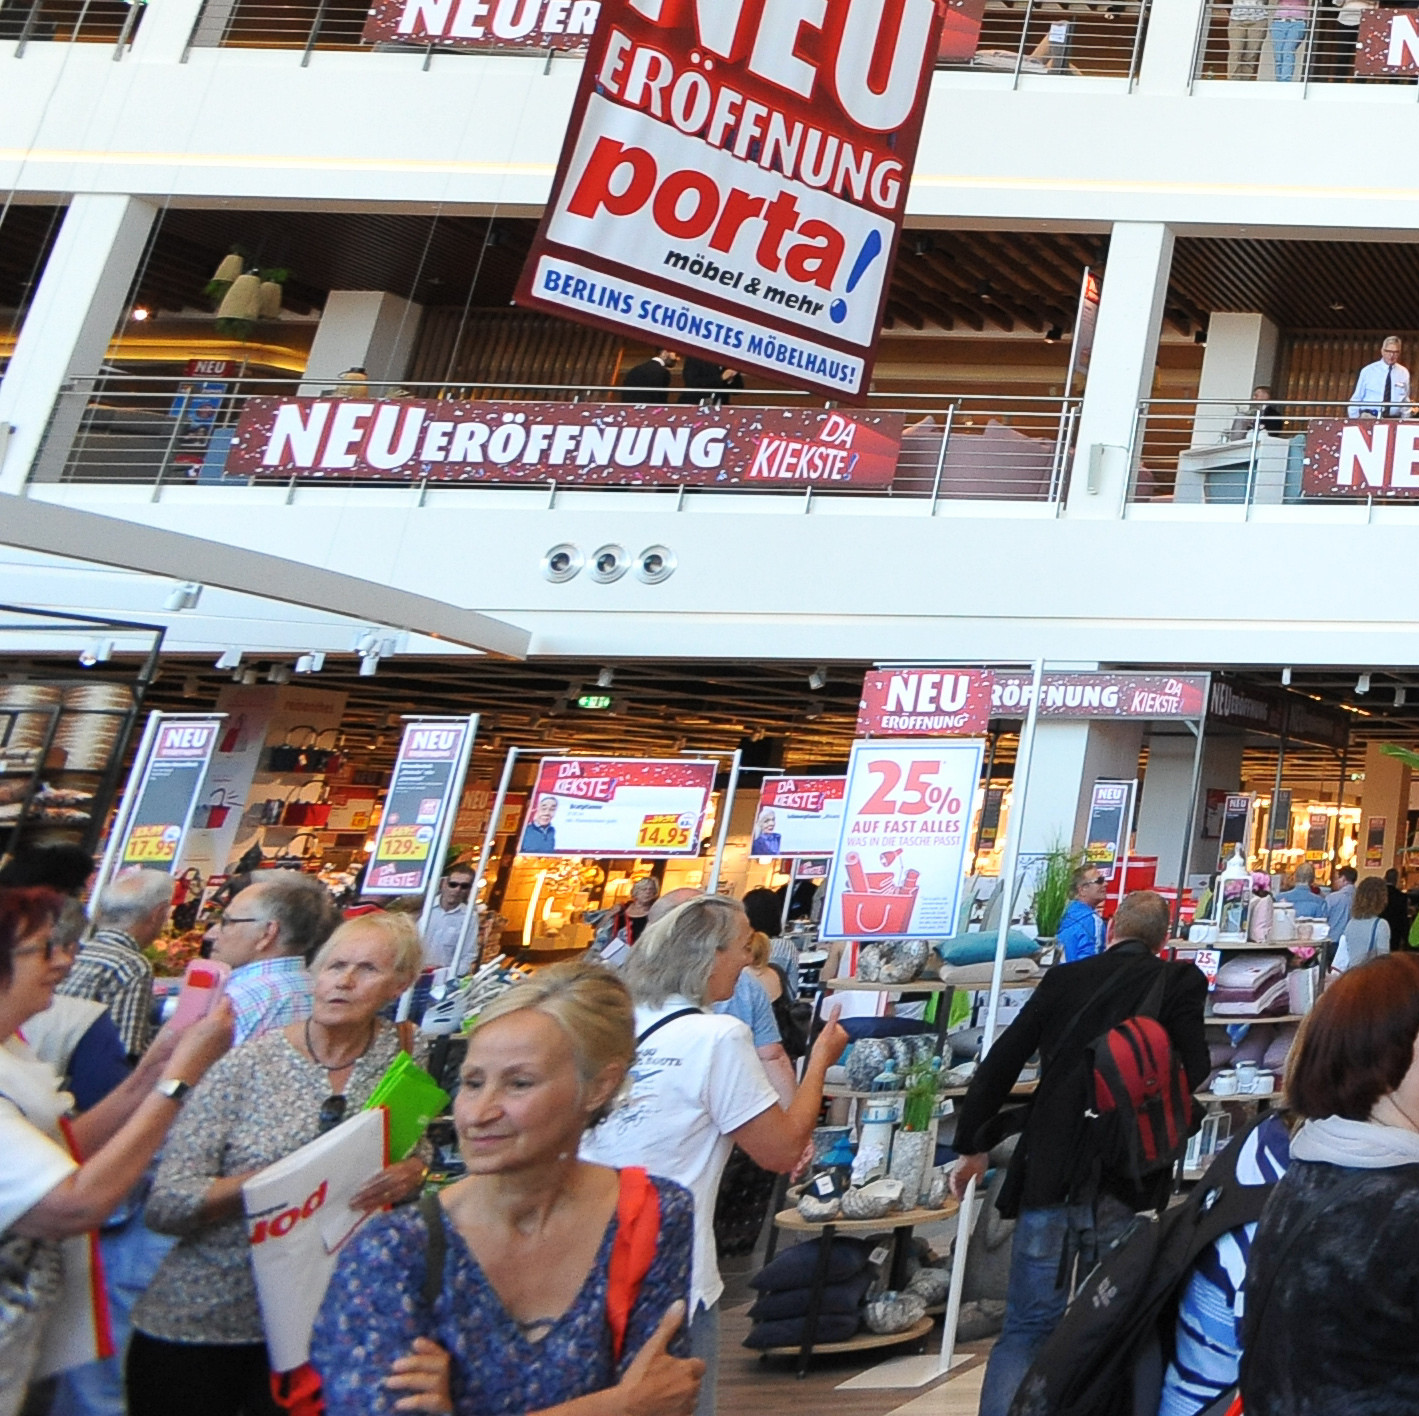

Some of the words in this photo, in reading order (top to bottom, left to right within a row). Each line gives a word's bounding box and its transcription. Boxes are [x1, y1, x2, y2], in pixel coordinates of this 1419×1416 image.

[599, 30, 903, 210] ERÖFFNUNG
[663, 249, 743, 292] möbel
[744, 275, 761, 296] &
[762, 281, 825, 316] mehr
[544, 269, 635, 315] BERLINS
[638, 299, 744, 350] SCHÖNSTES
[747, 335, 857, 385] MÖBELHAUS!
[262, 402, 729, 469] NEUERÖFFNUNG
[819, 413, 856, 447] DA
[750, 437, 860, 481] KIEKSTE!
[885, 674, 969, 713] NEU
[1164, 679, 1183, 697] DA
[881, 713, 969, 730] ERÖFFNUNG
[164, 729, 209, 747] NEU
[411, 731, 454, 750] NEU
[558, 762, 581, 778] DA
[777, 780, 795, 793] DA
[858, 760, 961, 815] 25%
[1098, 788, 1122, 800] NEU
[1229, 799, 1247, 808] NEU
[638, 827, 689, 844] 14.95
[852, 820, 879, 833] AUF
[883, 820, 916, 833] FAST
[919, 820, 960, 833] ALLES
[129, 841, 174, 856] 17.95
[846, 837, 868, 847] WAS
[869, 837, 880, 846] IN
[881, 837, 896, 846] DIE
[898, 836, 932, 846] TASCHE
[933, 836, 961, 846] PASST
